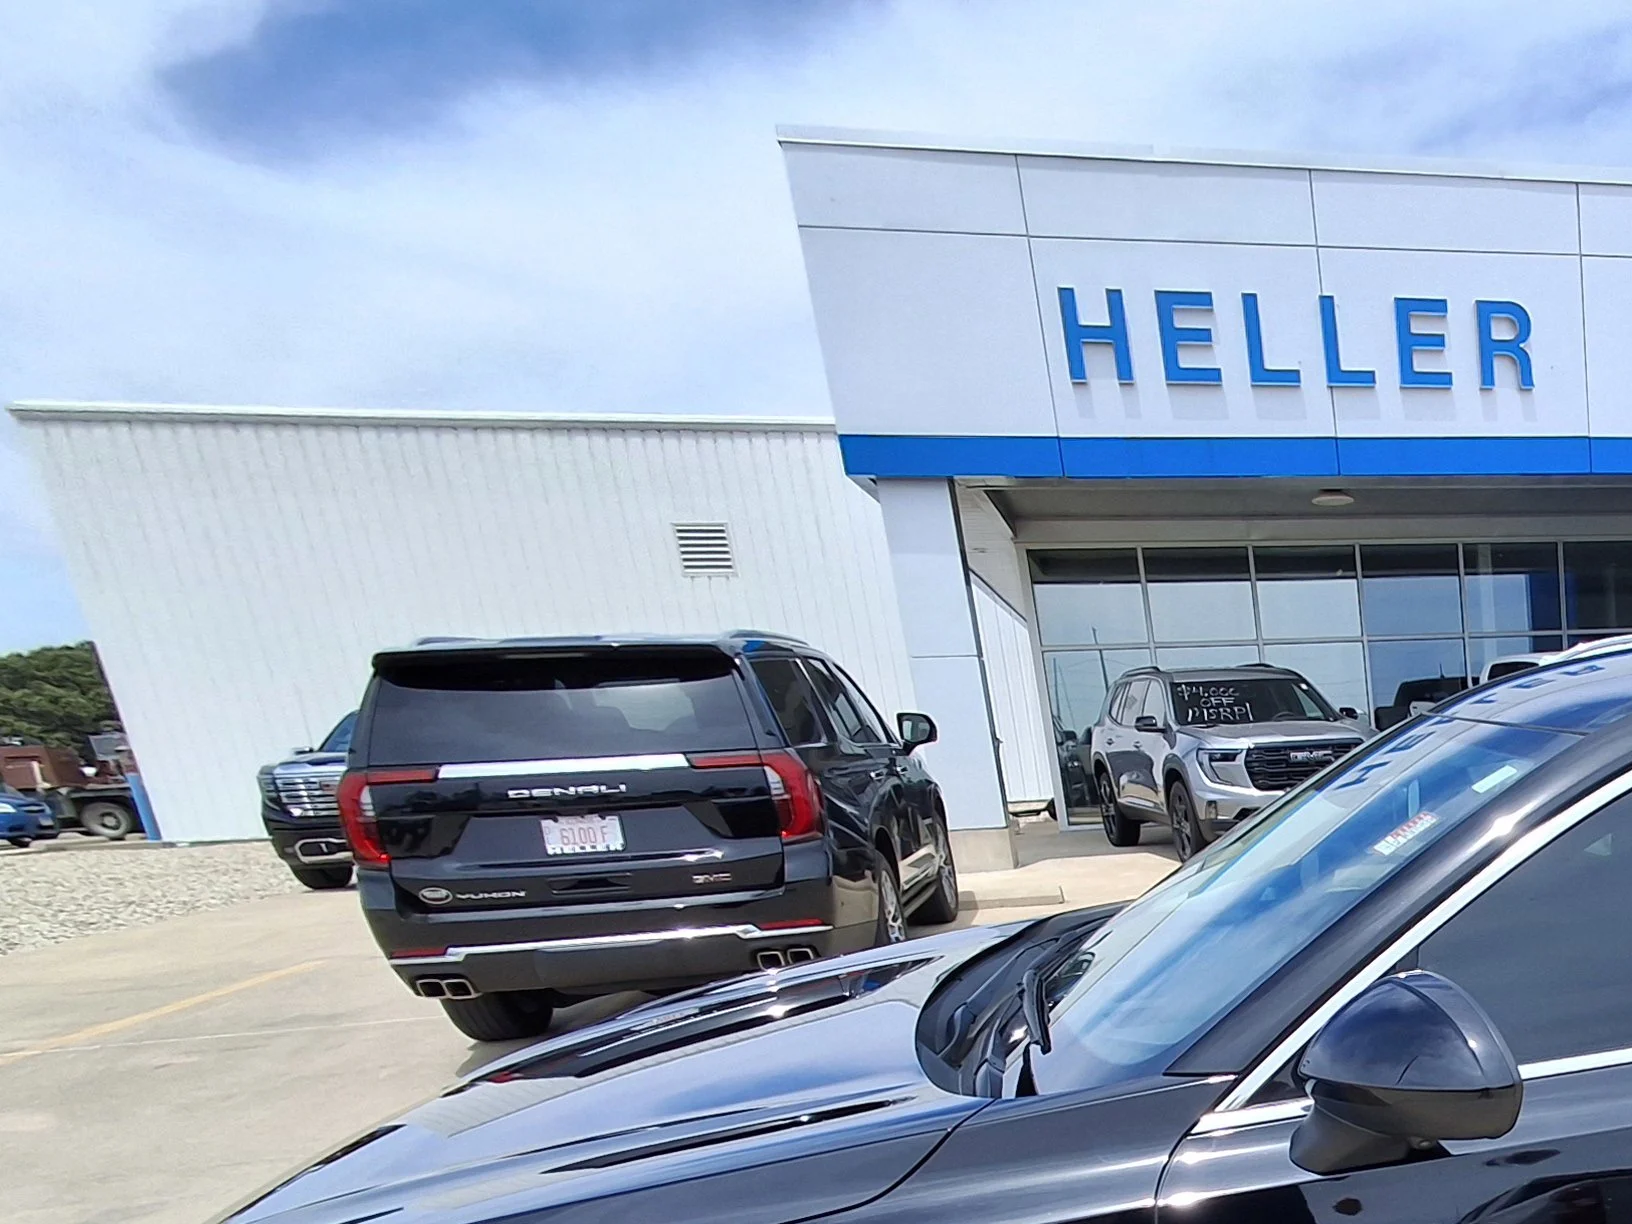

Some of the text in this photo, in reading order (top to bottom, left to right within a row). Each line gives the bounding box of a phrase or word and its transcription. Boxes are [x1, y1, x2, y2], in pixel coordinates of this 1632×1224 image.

[1057, 287, 1535, 391] HELLER
[1200, 697, 1235, 707] OFF
[507, 784, 627, 799] DENALI
[560, 825, 608, 846] 6100 F
[455, 890, 527, 899] YUKON
